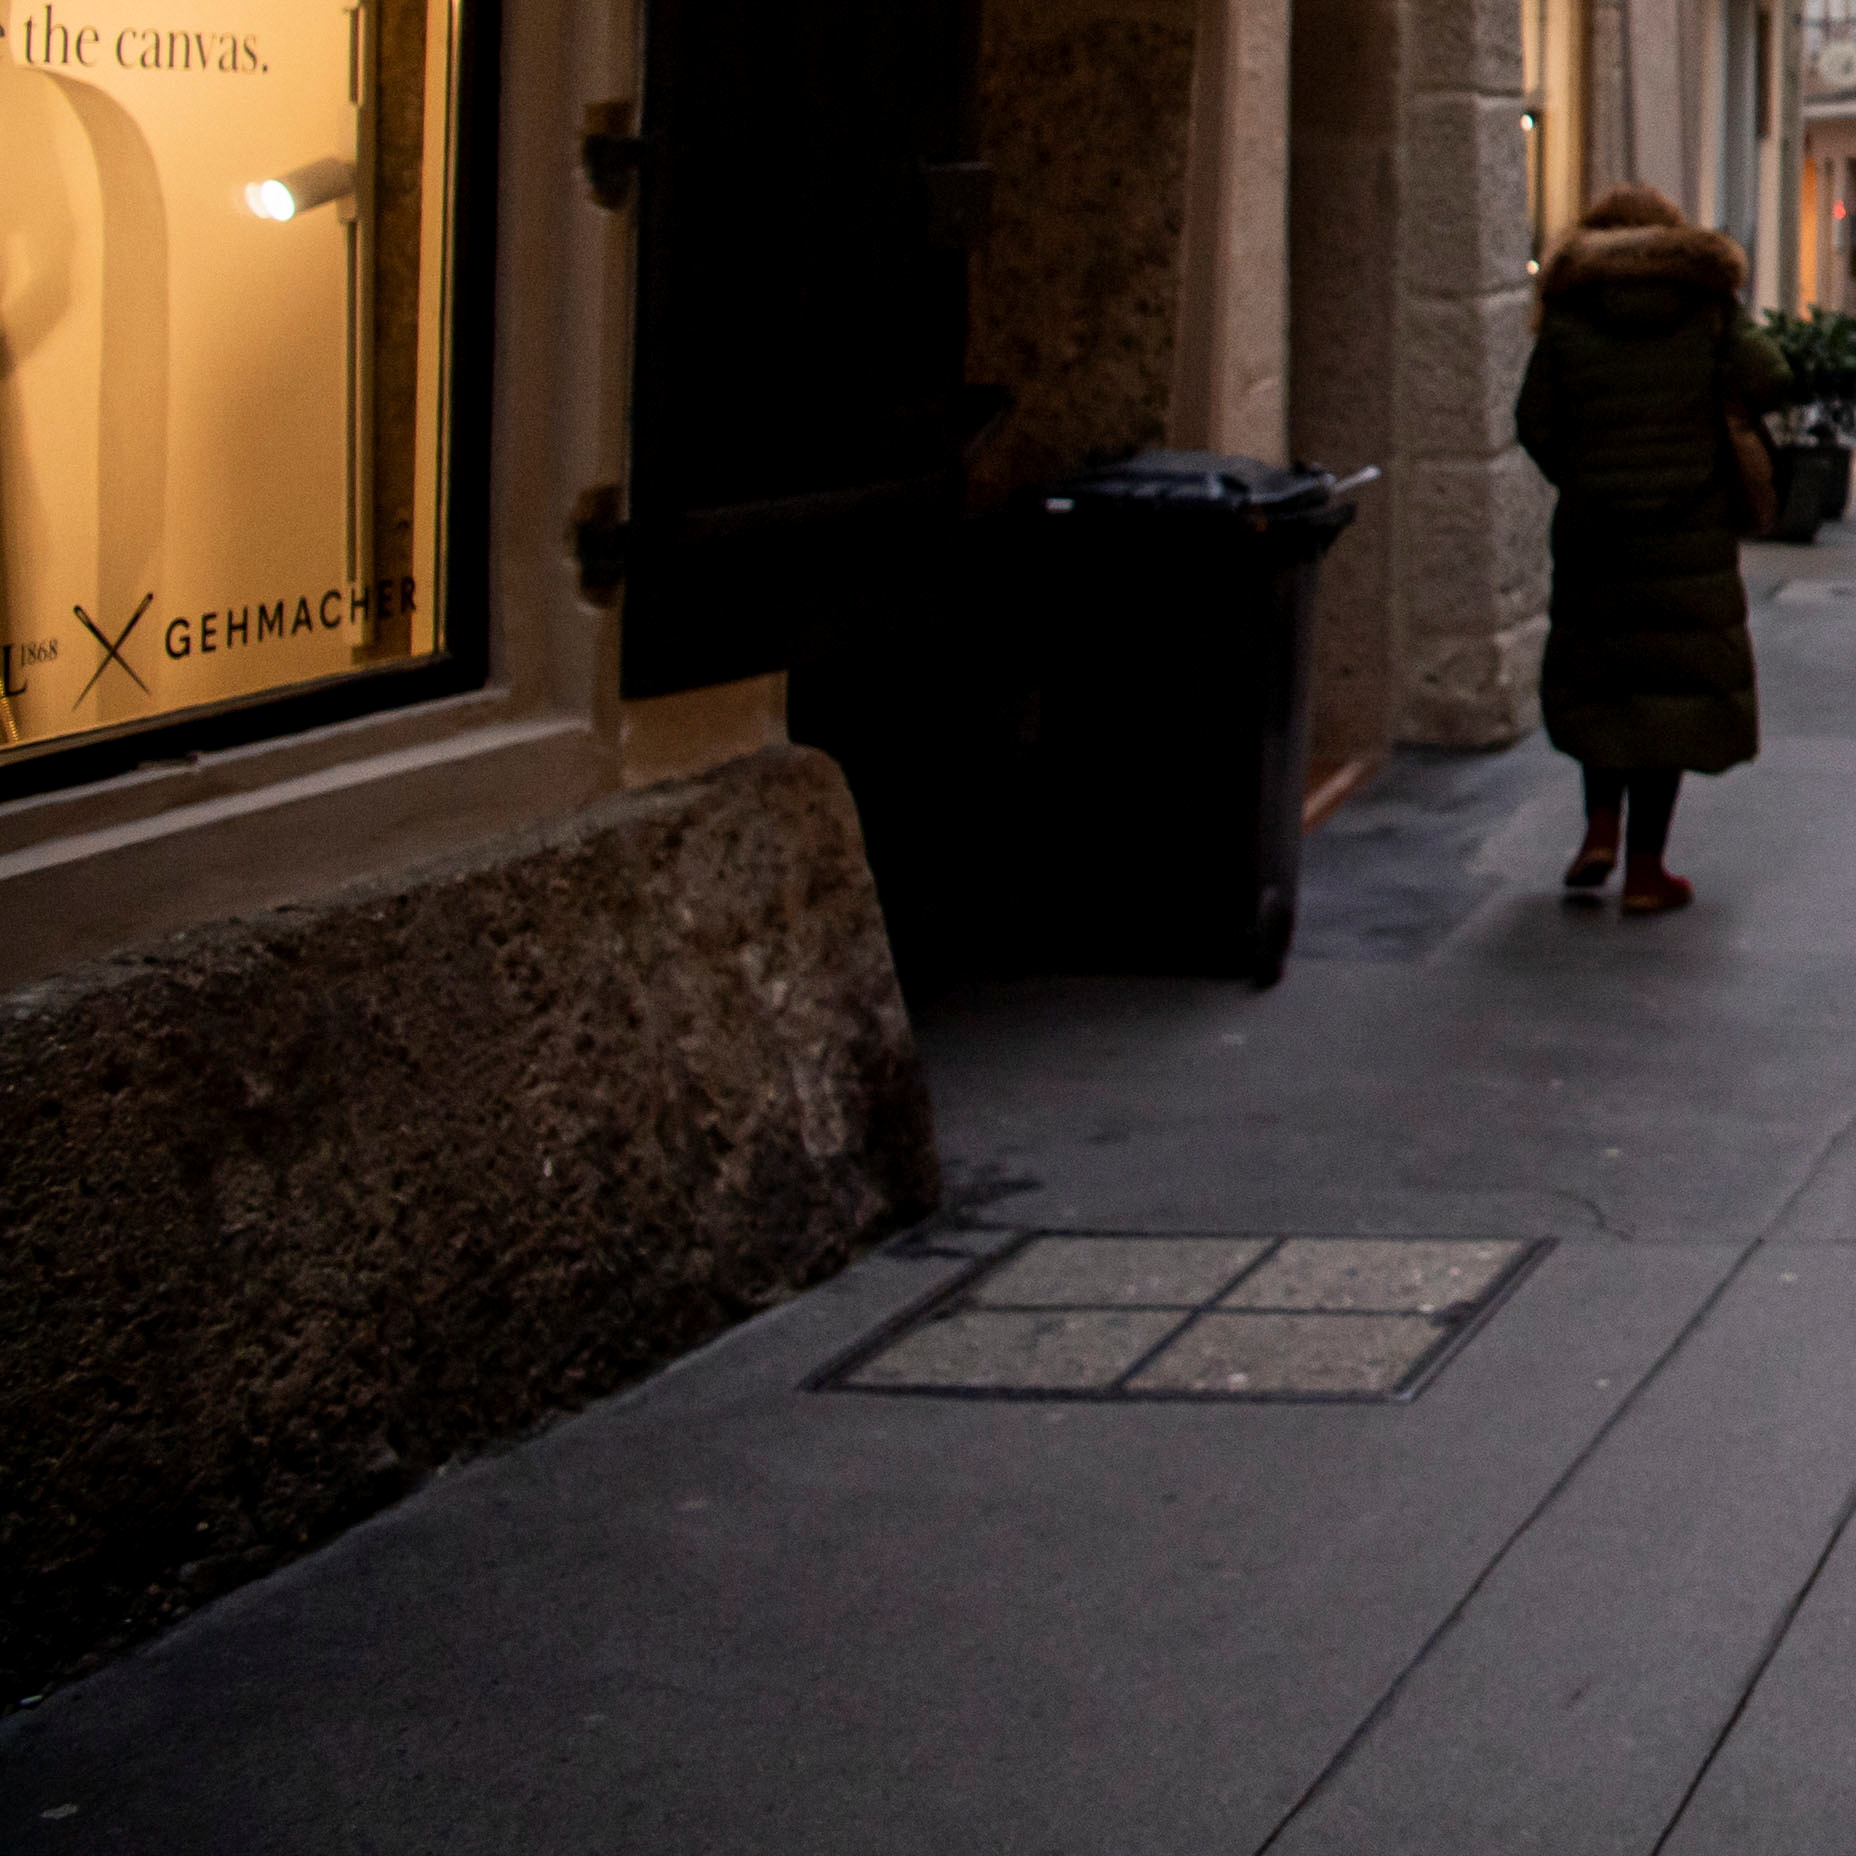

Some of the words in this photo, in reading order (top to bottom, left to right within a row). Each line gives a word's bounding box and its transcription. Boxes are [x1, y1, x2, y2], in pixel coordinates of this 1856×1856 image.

[24, 3, 100, 66] the
[116, 24, 269, 73] canvas.
[20, 639, 59, 668] 1868
[164, 576, 418, 660] GEHMACHER
